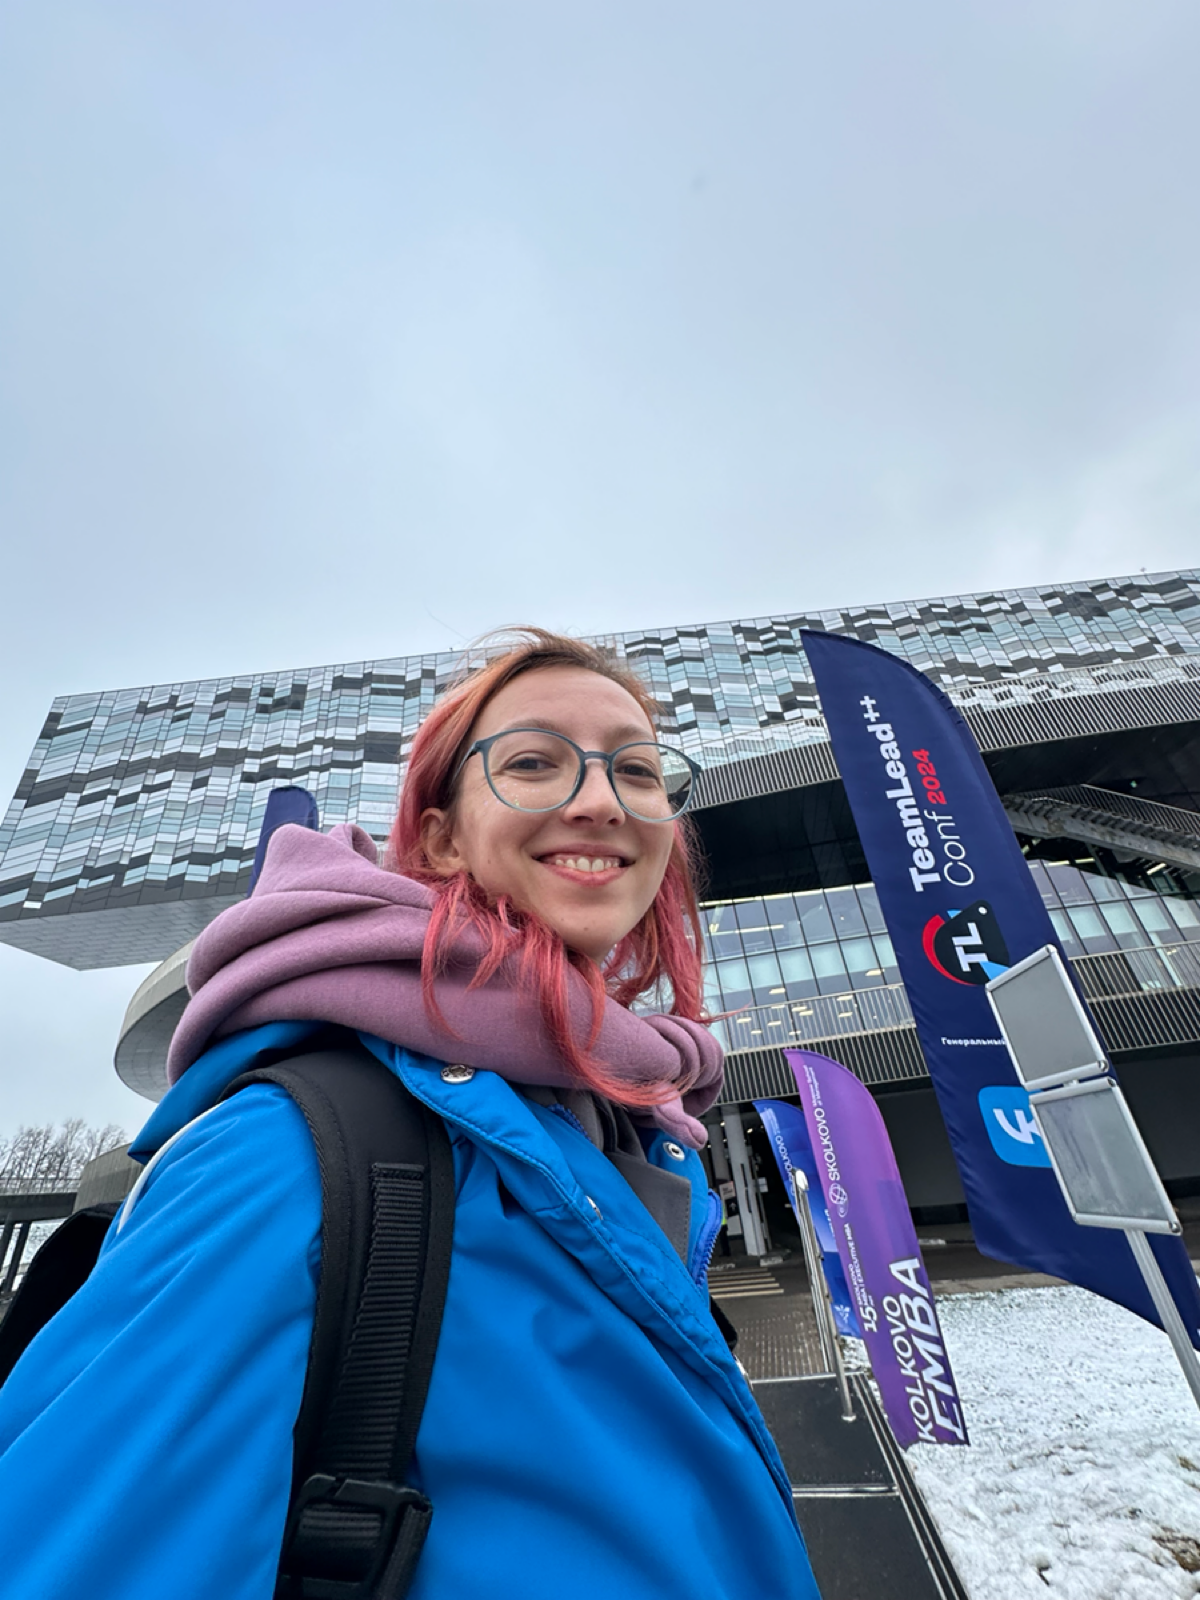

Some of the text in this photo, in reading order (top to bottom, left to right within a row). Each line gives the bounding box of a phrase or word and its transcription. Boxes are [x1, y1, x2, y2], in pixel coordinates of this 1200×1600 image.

[859, 695, 941, 892] TeamLead++
[912, 749, 975, 886] Conf 2024
[952, 922, 989, 972] TL
[814, 1107, 841, 1181] SKOLKOVO
[844, 1223, 853, 1240] MBA
[860, 1306, 877, 1333] 15
[883, 1295, 937, 1443] KOLKOVO
[889, 1257, 965, 1442] EMBA
